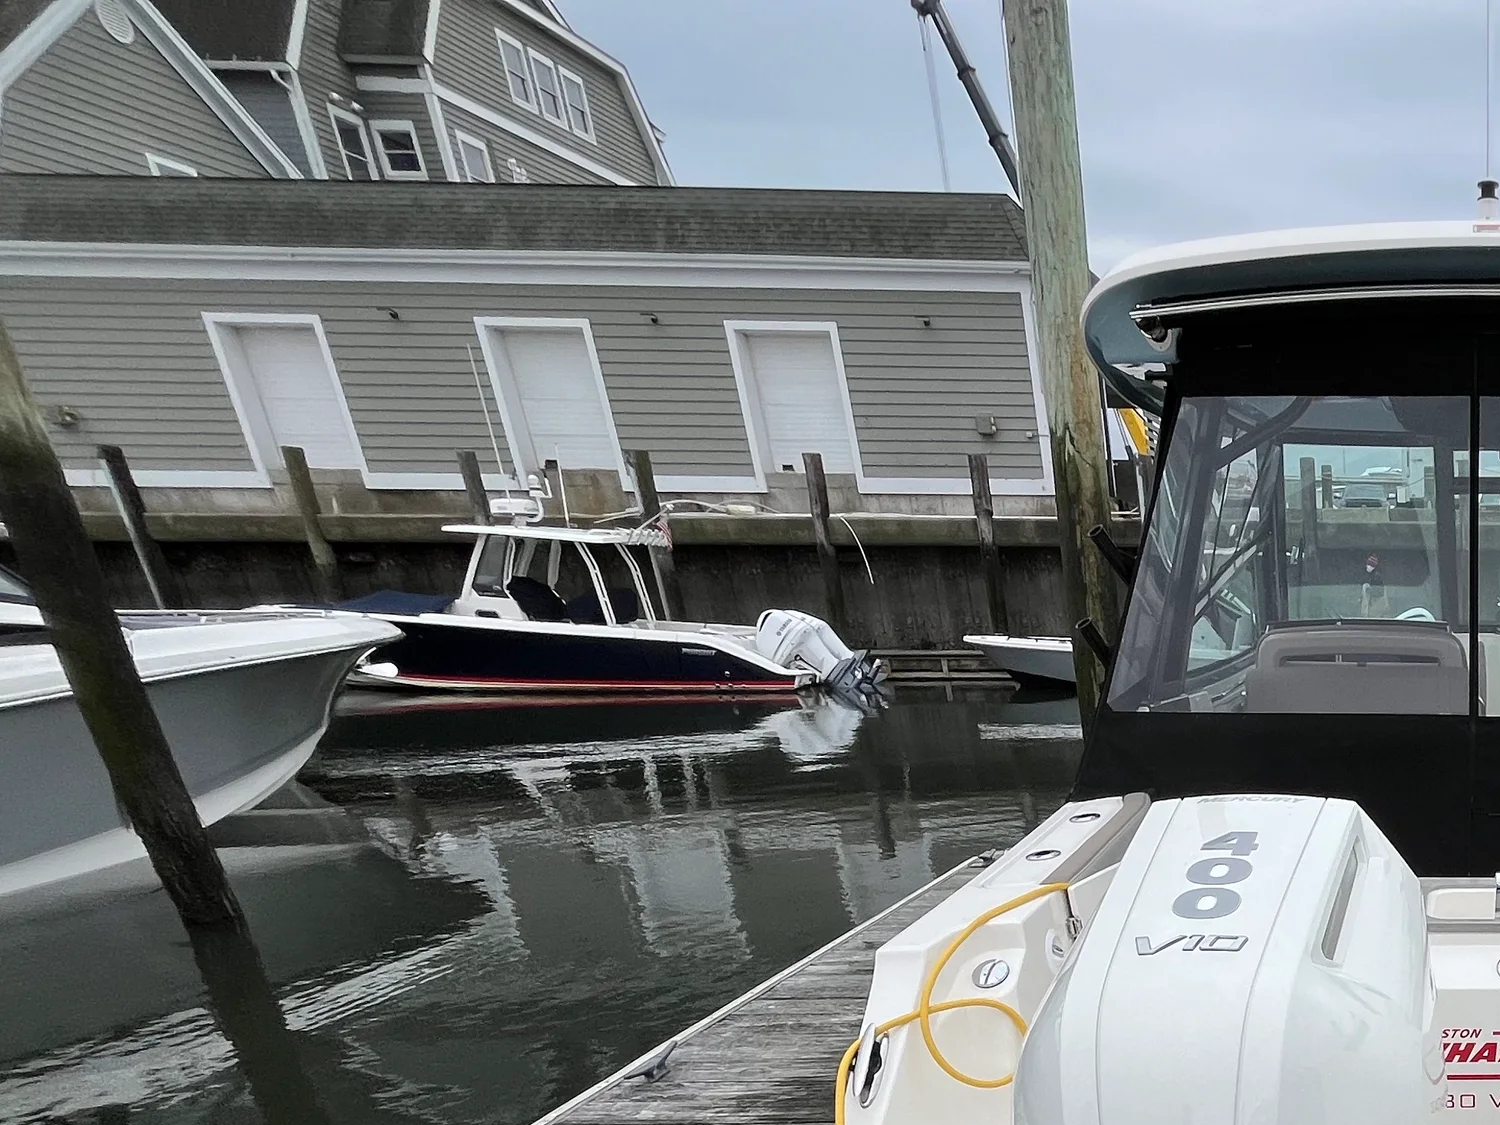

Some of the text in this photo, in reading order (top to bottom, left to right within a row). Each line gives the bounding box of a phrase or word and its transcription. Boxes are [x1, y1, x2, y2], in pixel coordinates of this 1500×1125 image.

[1172, 831, 1260, 920] 400
[1135, 934, 1249, 956] V10
[1441, 1028, 1482, 1039] STON
